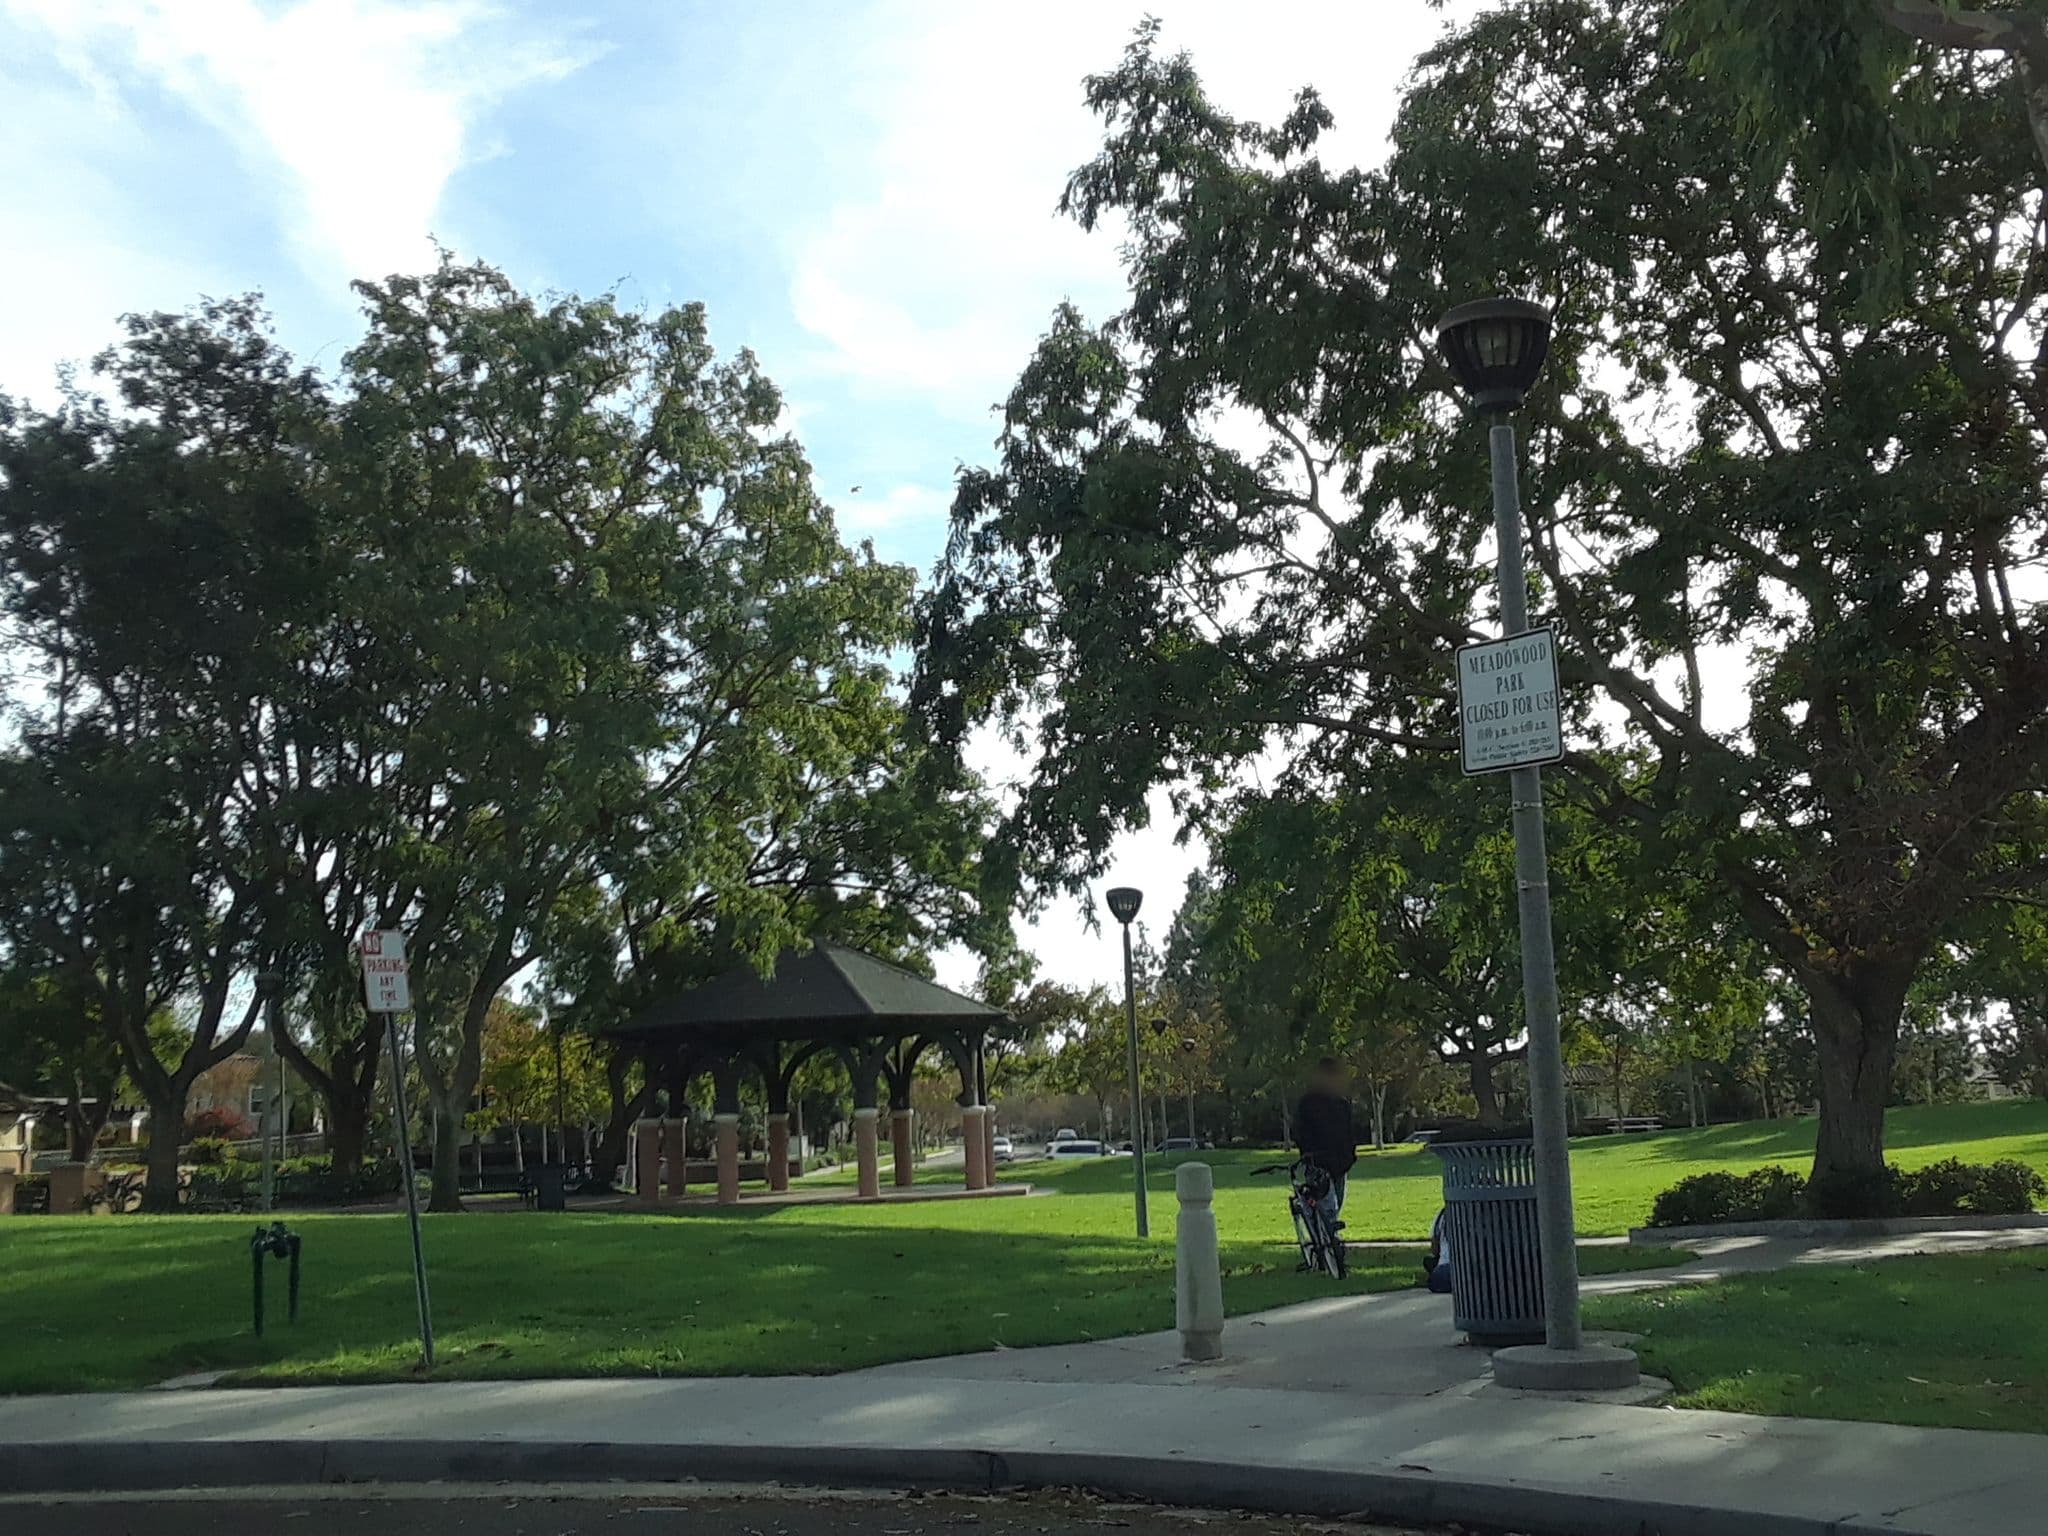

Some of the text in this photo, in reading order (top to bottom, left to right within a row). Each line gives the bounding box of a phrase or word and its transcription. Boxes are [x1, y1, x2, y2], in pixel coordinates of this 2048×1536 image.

[1469, 643, 1546, 673] MEADOWOOD
[1497, 672, 1525, 694] PARK
[1466, 691, 1554, 723] CLOSED FOR USE
[365, 935, 380, 953] NO
[368, 959, 404, 973] PARKING
[379, 976, 394, 986] ANY
[380, 990, 397, 1001] TIME
